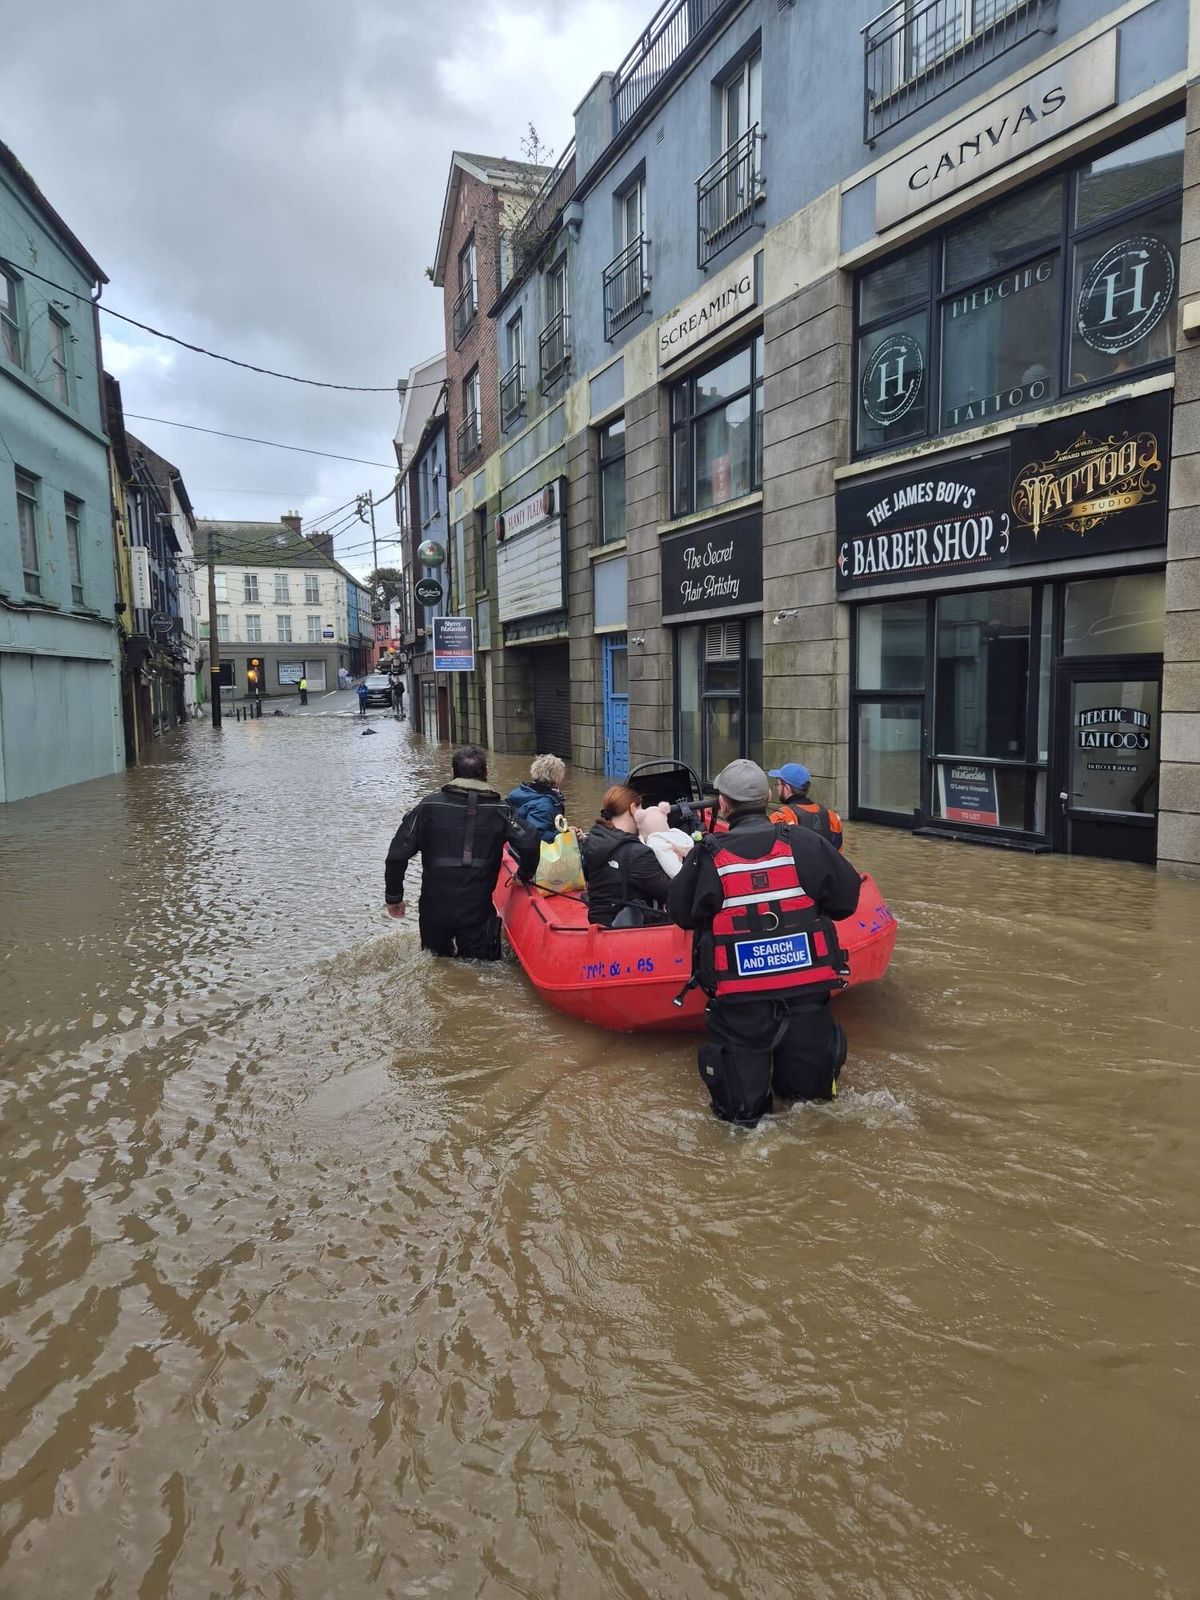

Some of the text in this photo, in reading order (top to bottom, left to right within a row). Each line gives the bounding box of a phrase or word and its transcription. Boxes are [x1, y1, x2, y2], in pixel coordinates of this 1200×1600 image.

[908, 86, 1067, 191] CANVAS
[952, 261, 1052, 319] PIERCING
[1099, 260, 1151, 325] H
[660, 275, 751, 351] SCREAMING
[876, 354, 908, 403] H
[952, 380, 1045, 425] TATTOO
[1057, 445, 1110, 462] AWARD WINNING
[1074, 439, 1094, 449] MULTI
[866, 481, 977, 527] THE JAMES BOY'S
[1020, 441, 1138, 543] TATTOO
[1080, 496, 1132, 513] STUDIO
[683, 540, 734, 570] The Secret
[852, 515, 994, 576] BARBER SHOP
[680, 574, 740, 605] Hair Artistry
[1080, 708, 1150, 728] HERETIC INK
[1079, 731, 1149, 749] TATTOOS
[743, 950, 807, 970] AND RESCUE
[752, 940, 793, 957] SEARCH
